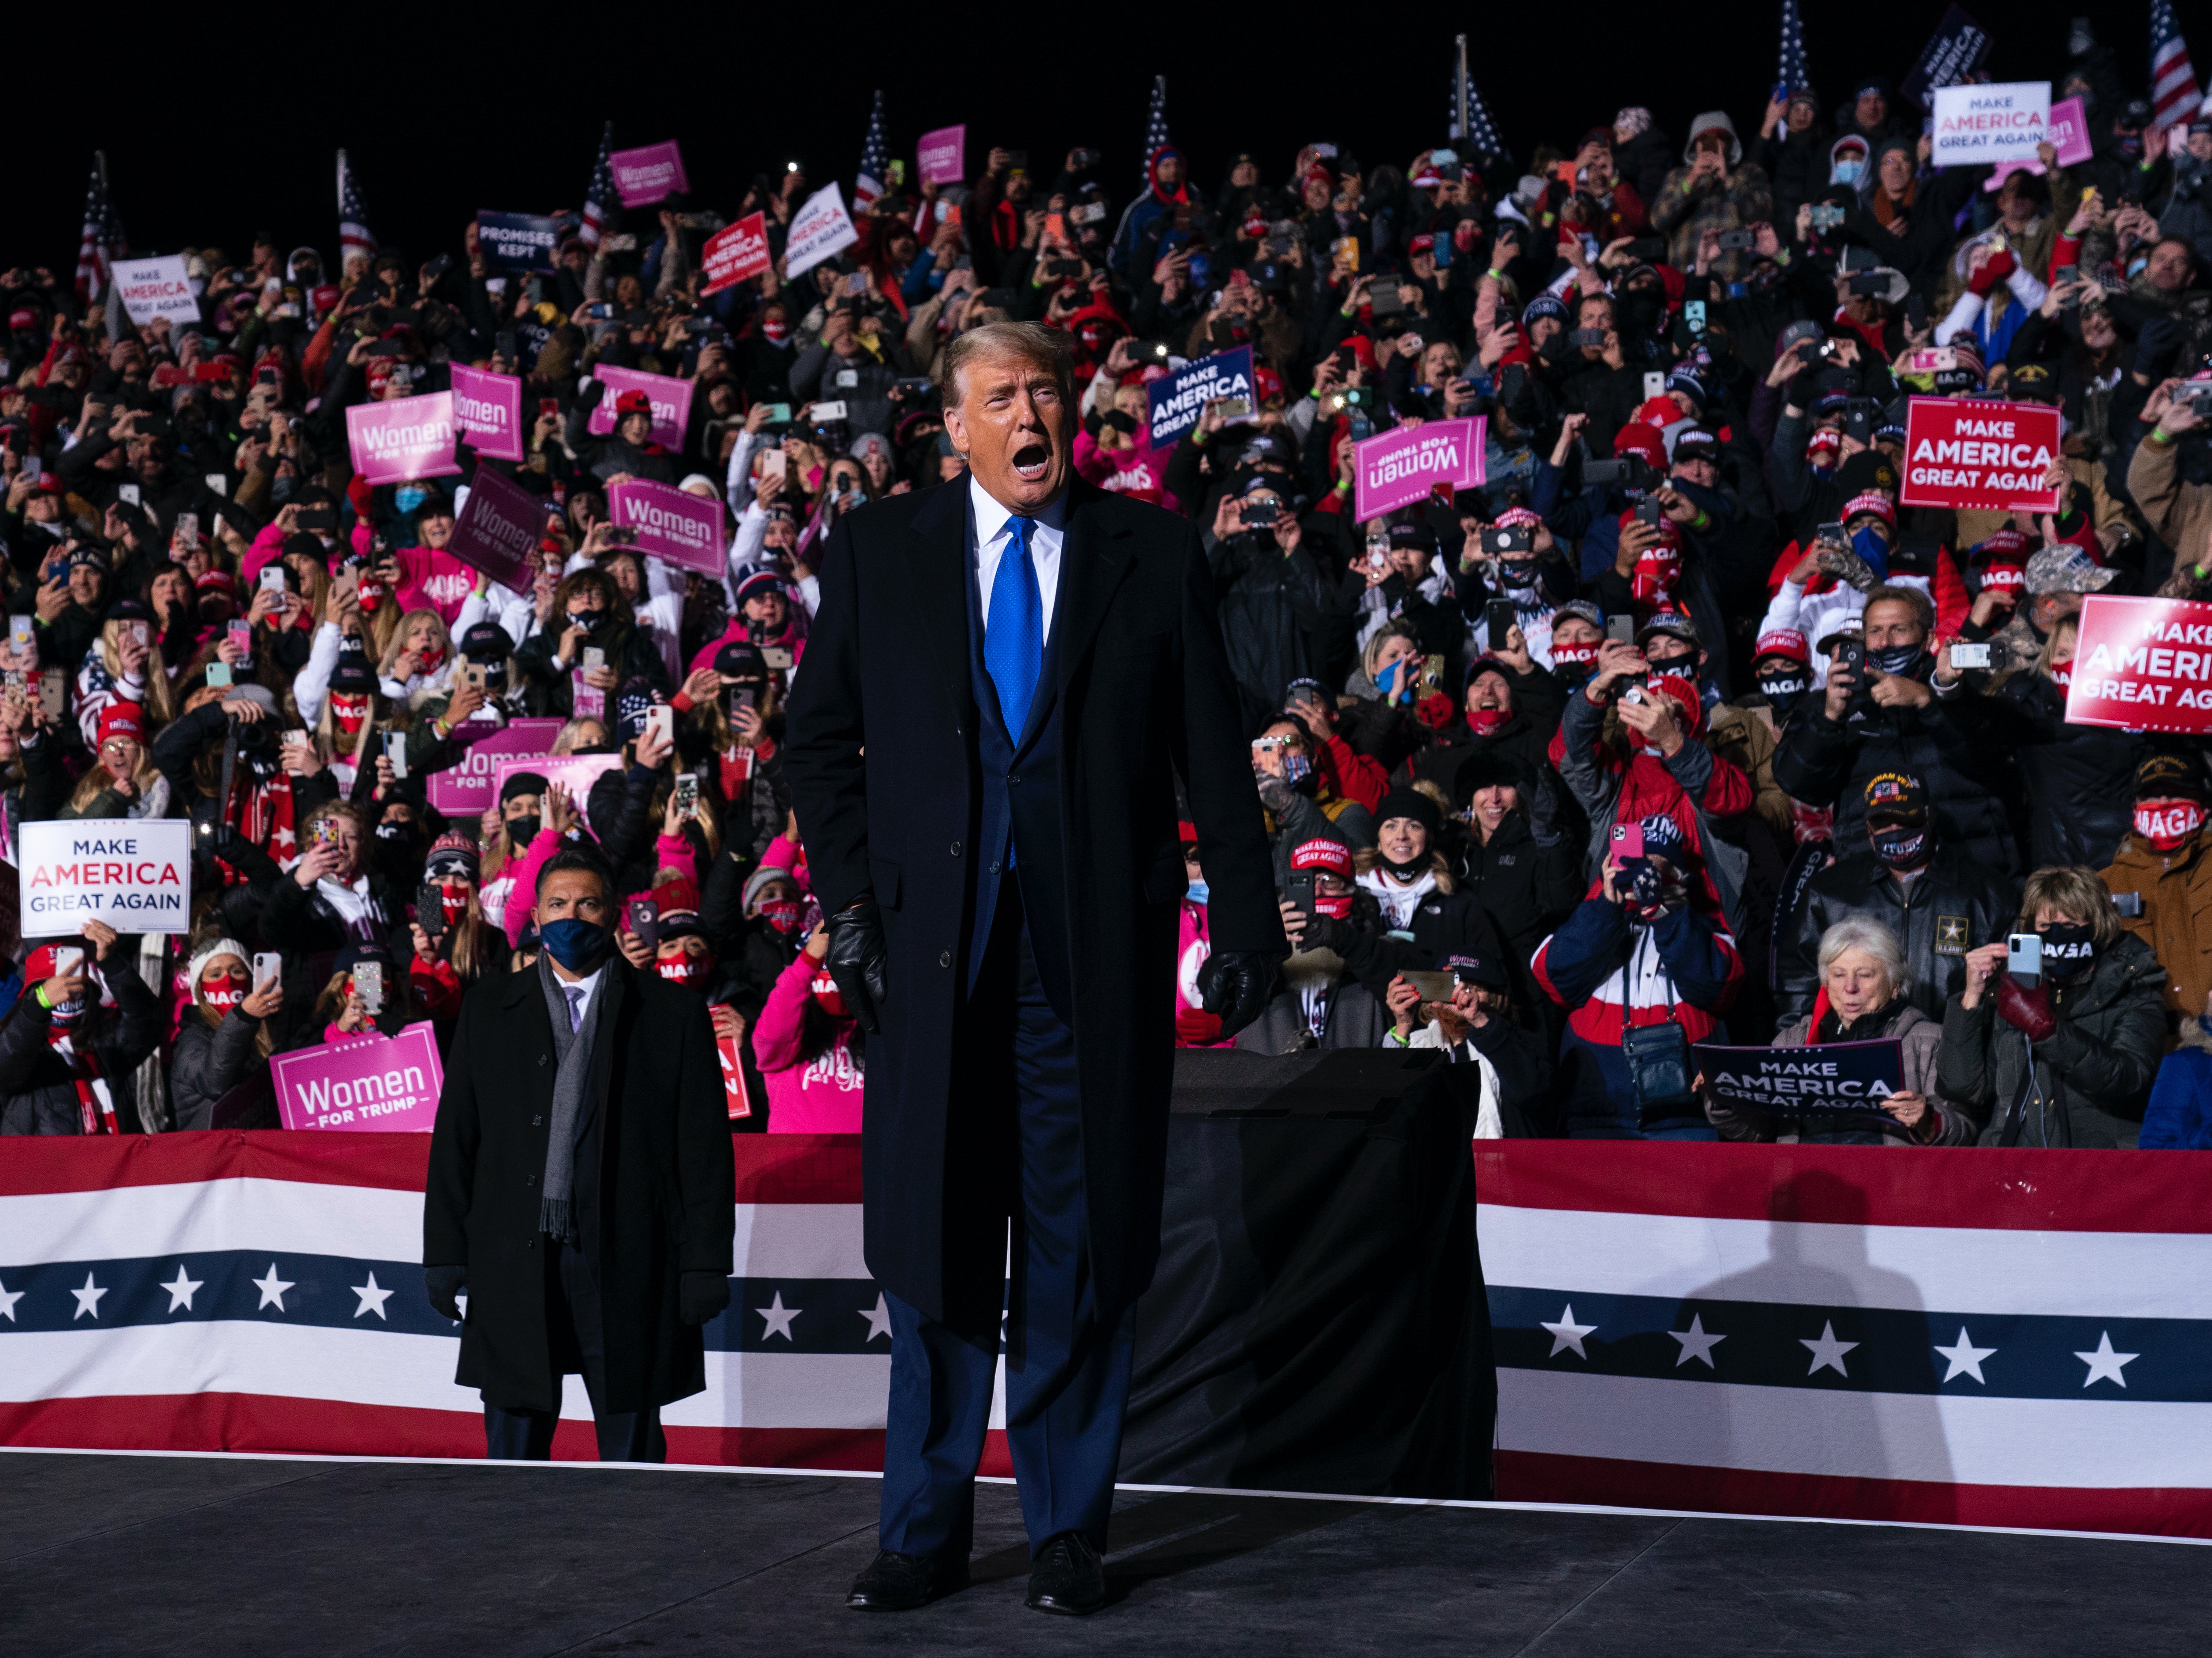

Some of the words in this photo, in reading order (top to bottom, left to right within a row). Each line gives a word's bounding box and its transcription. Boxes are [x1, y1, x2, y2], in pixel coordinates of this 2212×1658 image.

[1969, 97, 2014, 109] MAKE
[1940, 111, 2043, 132] AMERICA
[1939, 136, 1988, 149] GREAT
[1993, 132, 2044, 146] AGAIN
[479, 225, 555, 246] PROMISES
[497, 242, 536, 259] KEPT
[702, 233, 764, 271] AMERICA
[707, 262, 734, 281] REAT
[124, 281, 187, 299] AMERICA
[1175, 364, 1219, 391] MAKE
[1151, 373, 1250, 423] AMERICA
[1152, 409, 1203, 438] GREAT
[1953, 418, 2016, 439] MAKE
[362, 421, 452, 451] Women
[1420, 435, 1449, 449] FOR
[1914, 438, 2053, 470] AMERICA
[1369, 445, 1459, 489] Women
[1911, 468, 1981, 488] GREAT
[473, 496, 536, 552] Women
[624, 497, 712, 542] Women
[1641, 547, 1677, 560] AGA
[2084, 643, 2212, 685] AMERI
[2081, 680, 2173, 707] GREAT
[332, 703, 367, 718] MAG
[456, 776, 486, 789] FOR
[1866, 772, 1896, 794] VIETNAM
[2137, 807, 2199, 839] MAGA
[73, 839, 138, 855] MAKE
[1314, 840, 1348, 856] AMERICA
[1297, 852, 1319, 866] GREAT
[1320, 852, 1343, 865] AGAIN
[30, 862, 181, 888] AMERICA
[1790, 850, 1822, 913] GREA
[30, 894, 104, 912] GREAT
[111, 894, 181, 910] AGAIN
[1449, 954, 1479, 967] Women
[2041, 942, 2094, 958] AGA
[203, 987, 243, 1006] MAG
[1760, 1062, 1839, 1077] MAKE
[295, 1064, 425, 1115] Women
[1715, 1072, 1893, 1098] AMERICA
[1716, 1087, 1803, 1107] GREAT
[1812, 1098, 1885, 1110] AGAI
[318, 1112, 355, 1128] FOR
[358, 1096, 417, 1118] TRUMP
